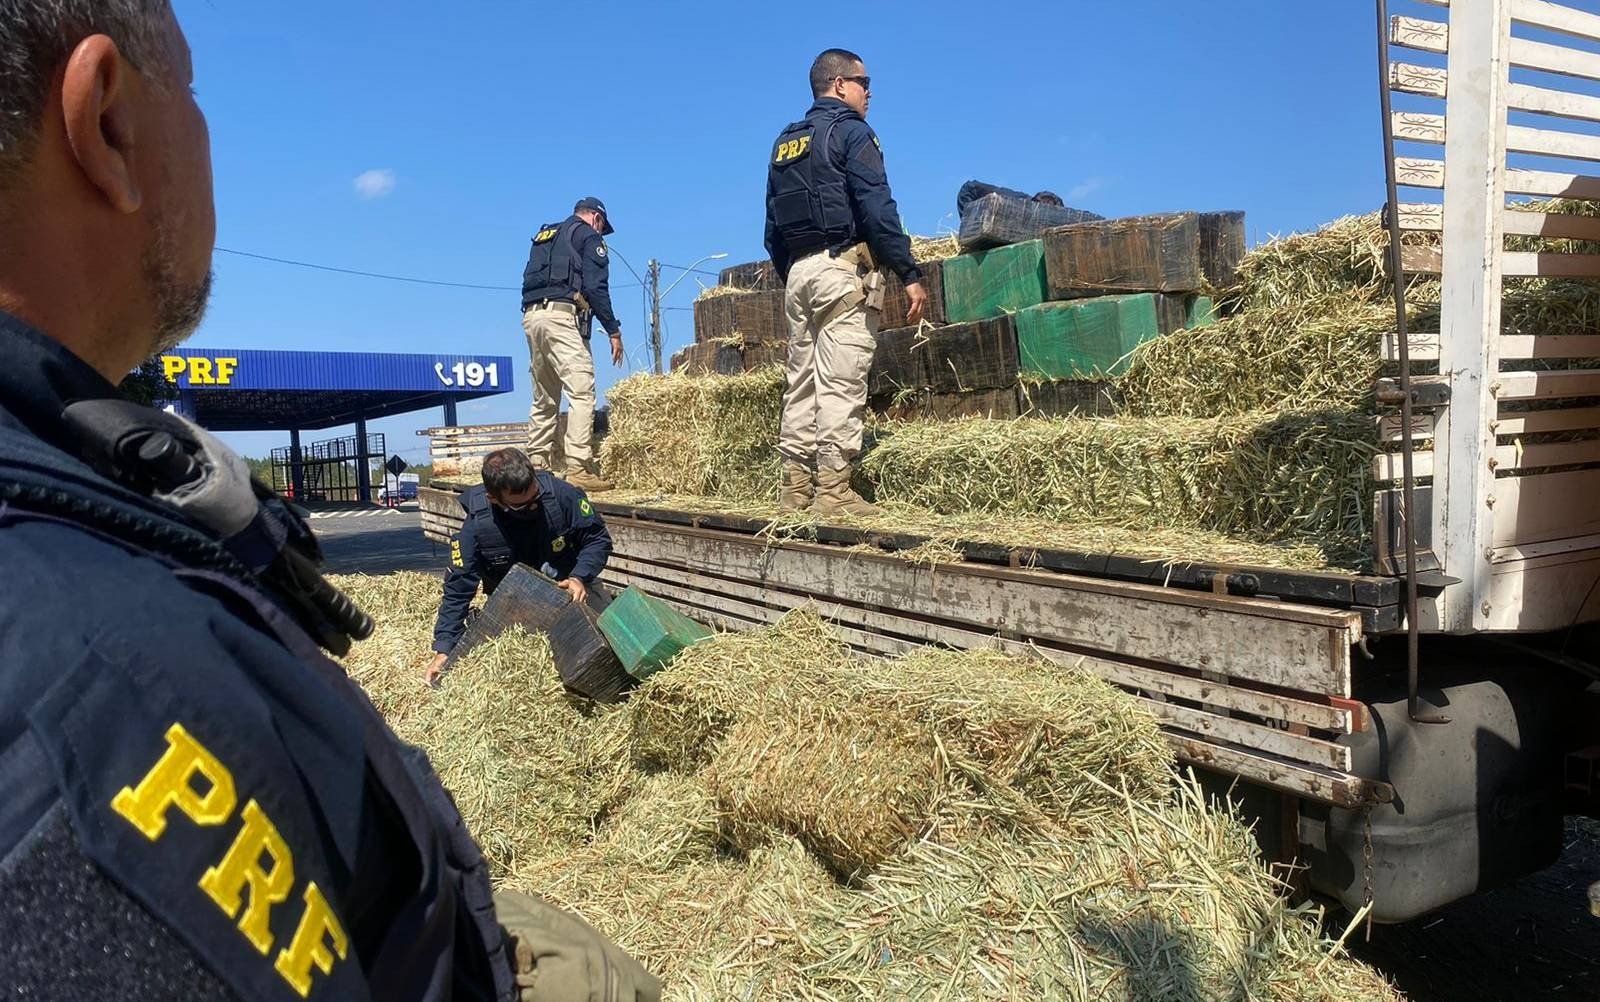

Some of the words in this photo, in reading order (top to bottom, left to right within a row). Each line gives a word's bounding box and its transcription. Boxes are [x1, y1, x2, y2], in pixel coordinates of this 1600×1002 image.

[775, 135, 811, 162] PRF
[161, 355, 237, 384] PRF
[452, 361, 499, 387] 191
[451, 540, 464, 567] PRF
[111, 722, 348, 997] PRF
